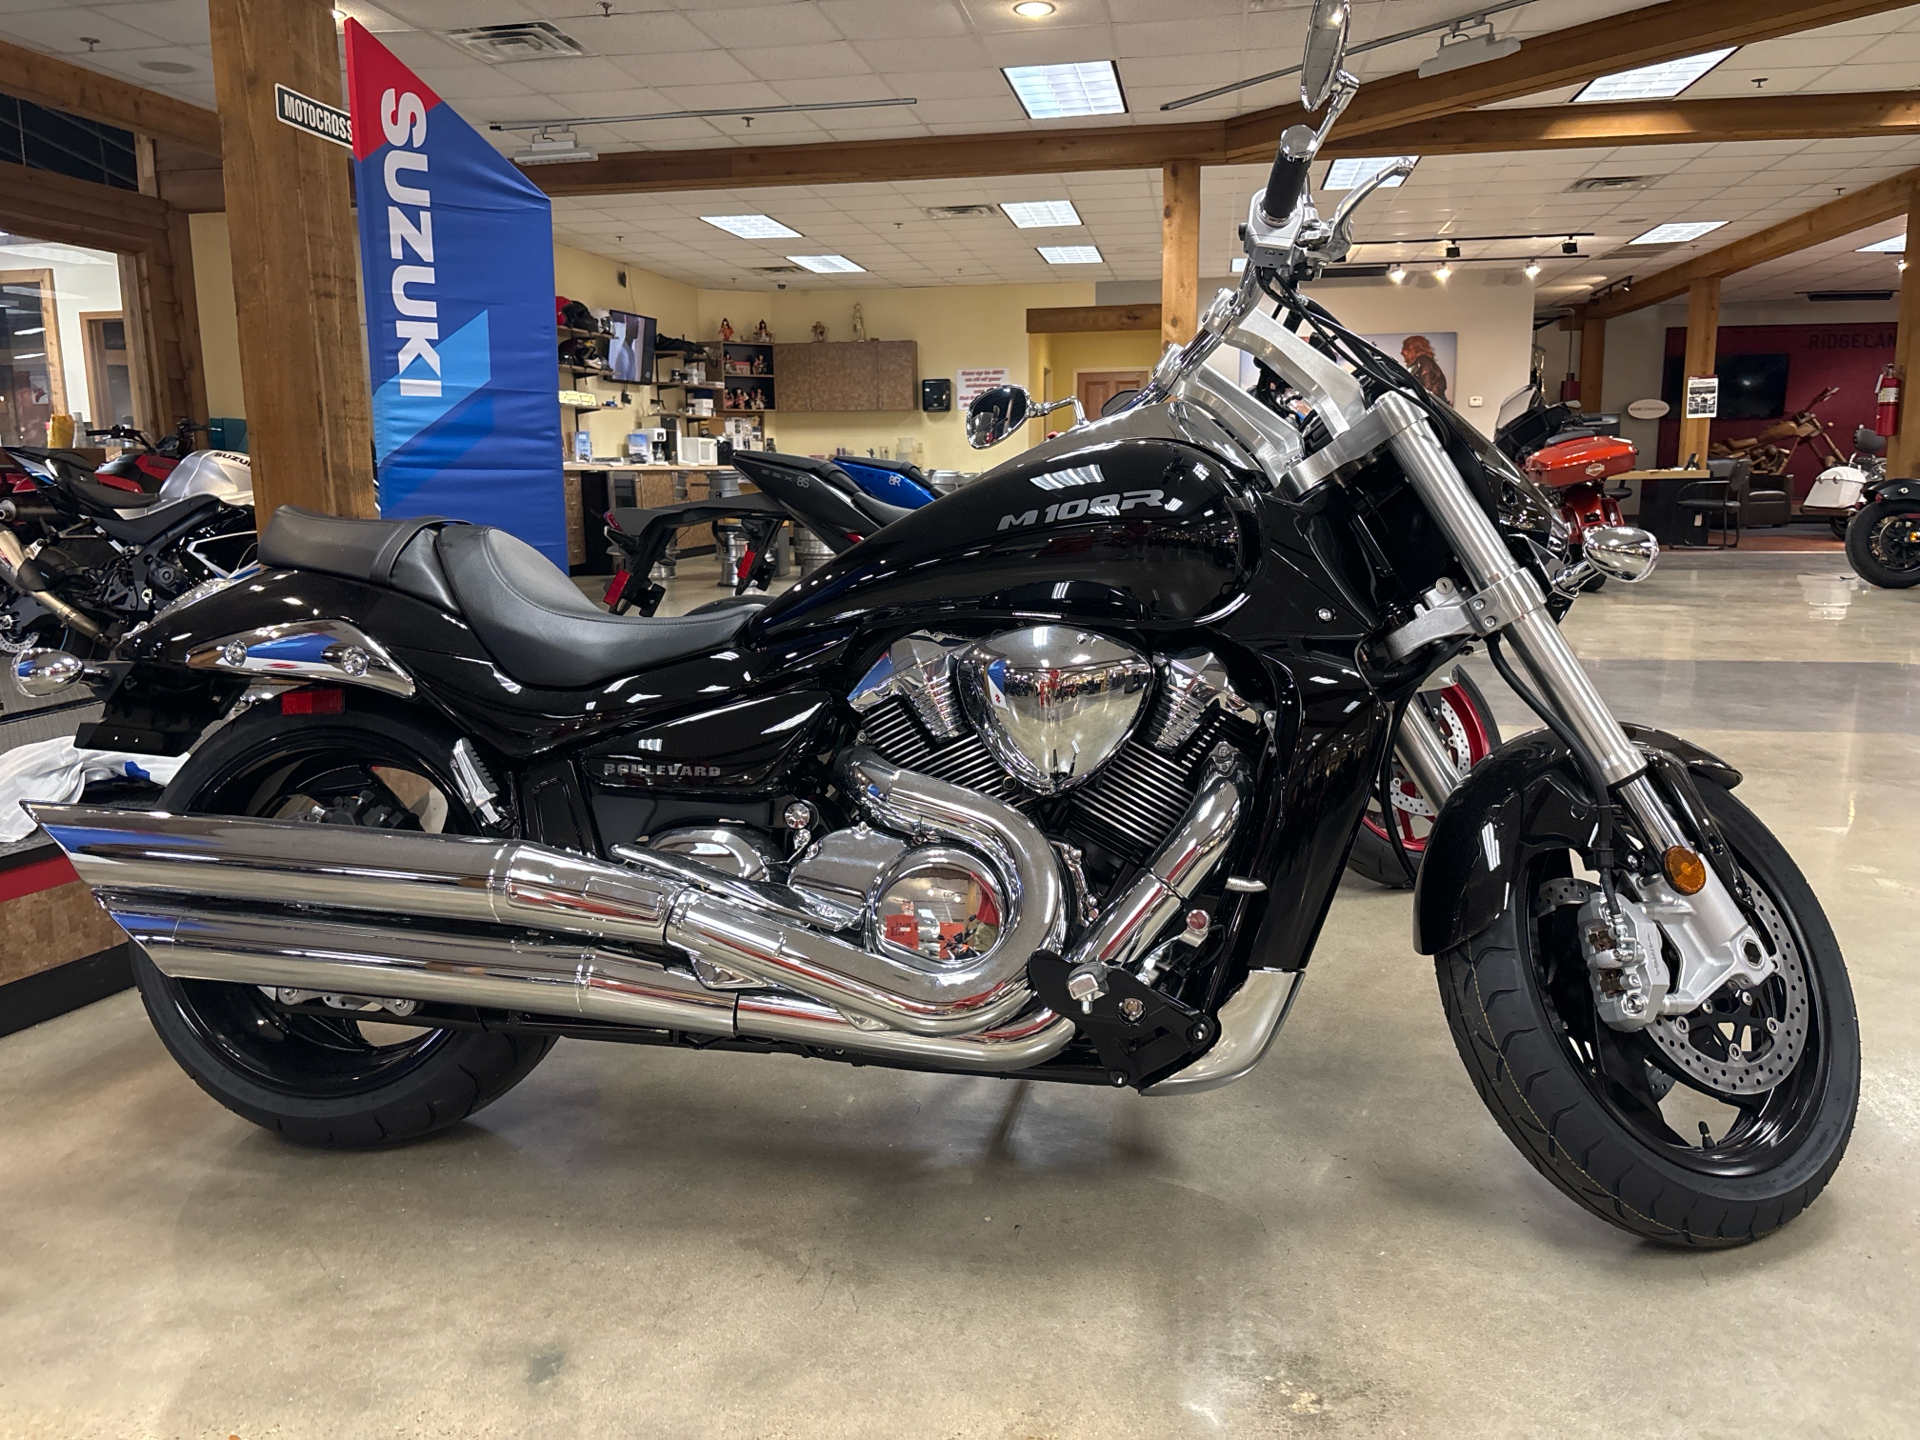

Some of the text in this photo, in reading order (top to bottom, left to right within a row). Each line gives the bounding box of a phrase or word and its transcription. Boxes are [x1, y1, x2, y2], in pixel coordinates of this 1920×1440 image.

[283, 93, 353, 142] MOTOCROSS
[381, 88, 442, 397] SUZUKI
[213, 452, 251, 467] SUZU
[604, 763, 721, 777] BOULEVARD
